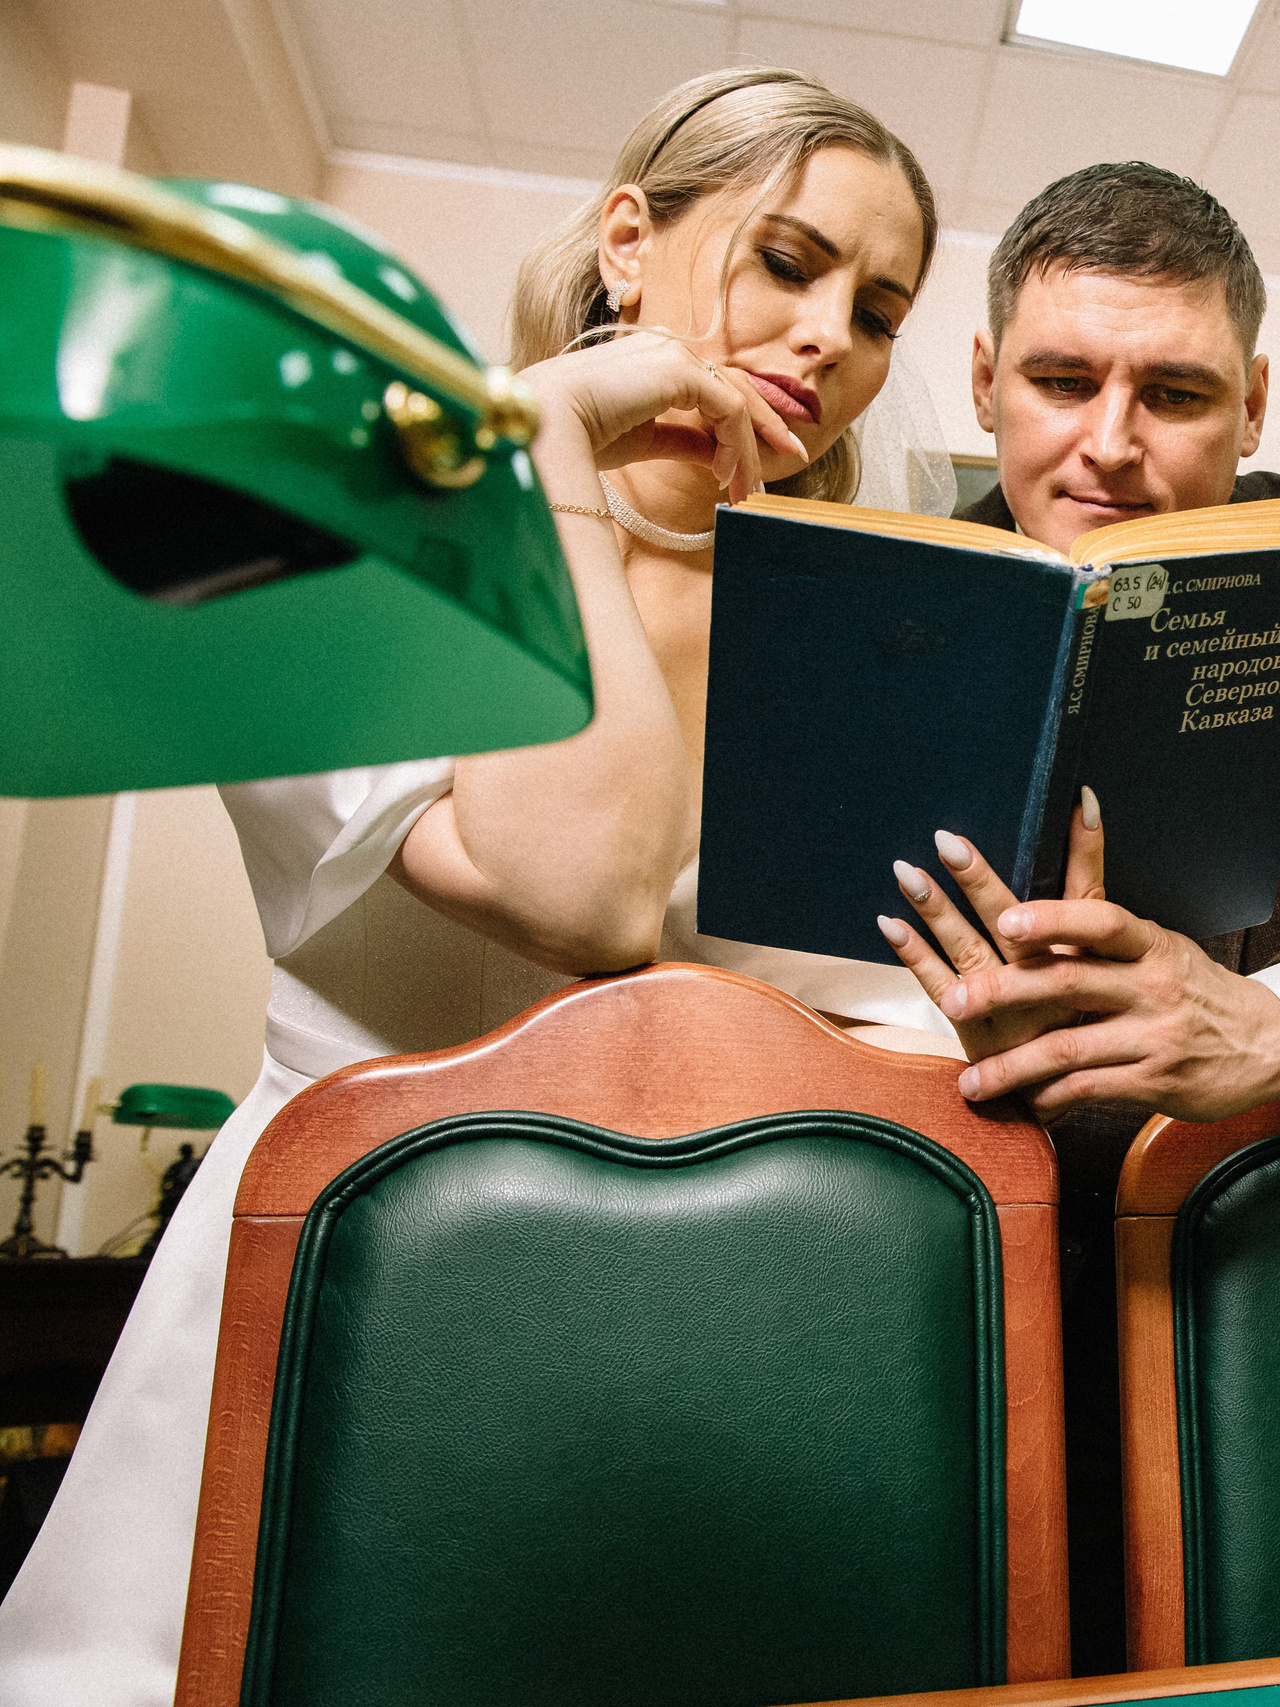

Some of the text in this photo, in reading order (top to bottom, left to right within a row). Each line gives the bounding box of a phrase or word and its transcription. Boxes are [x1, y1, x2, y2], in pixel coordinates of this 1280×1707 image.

[1185, 573, 1262, 593] СМИРНОВА
[1127, 596, 1142, 609] 50
[1150, 607, 1228, 633] Семья
[1143, 644, 1161, 661] и
[1178, 705, 1275, 734] Кавказа
